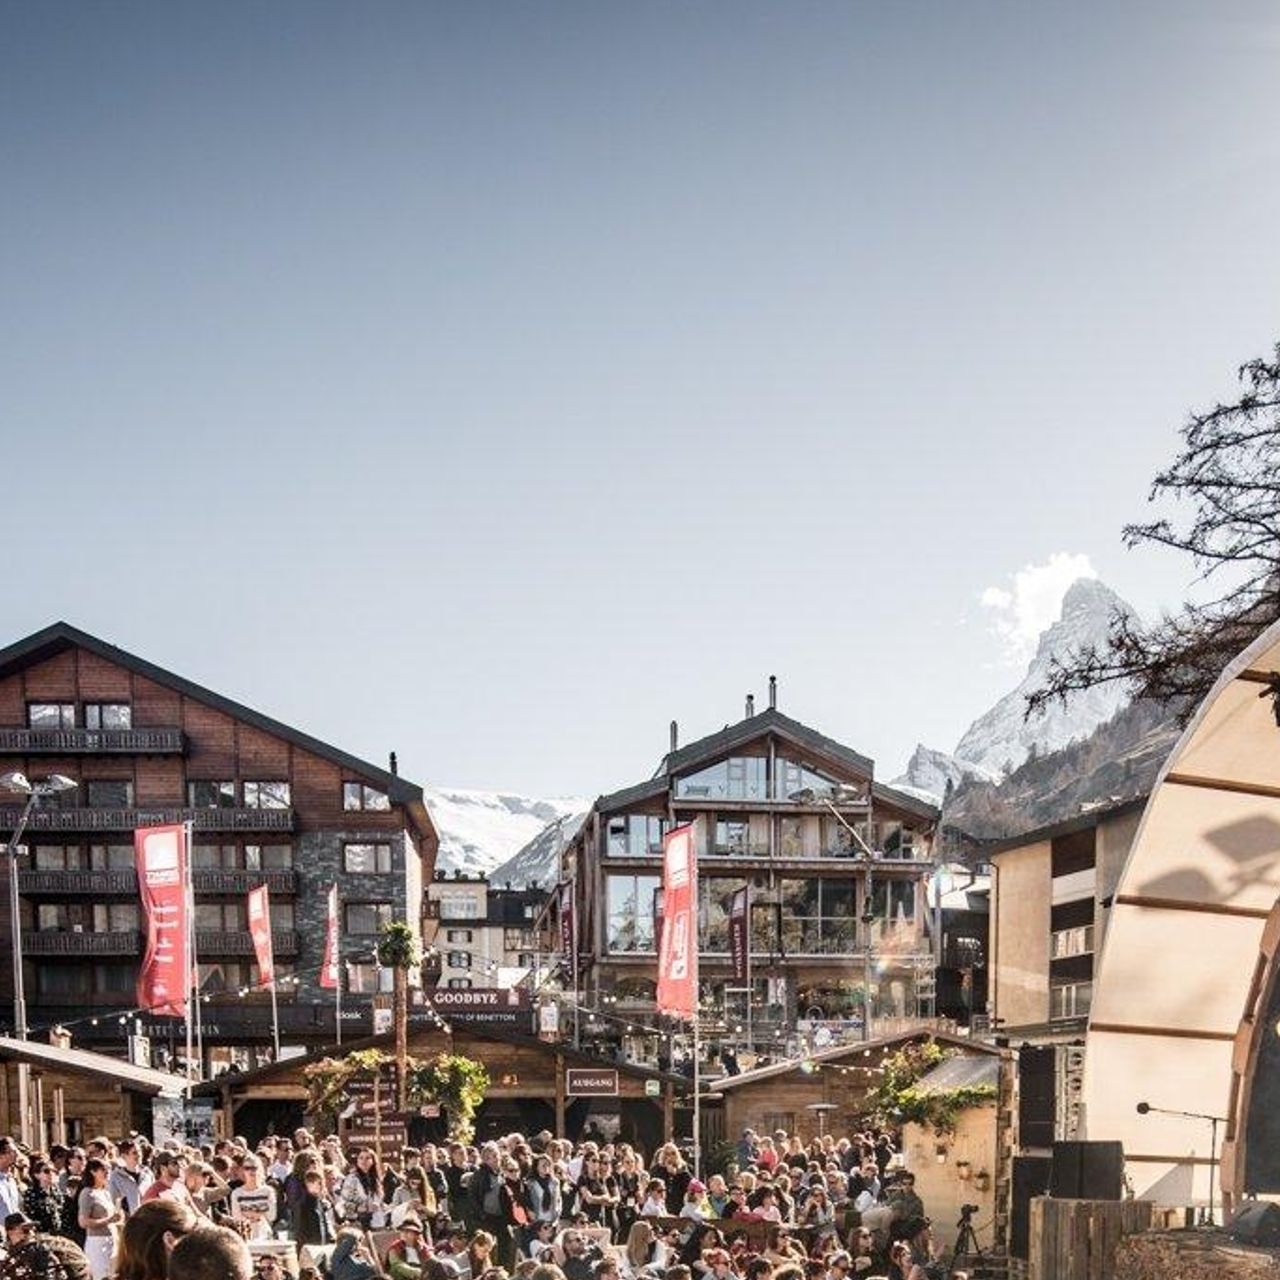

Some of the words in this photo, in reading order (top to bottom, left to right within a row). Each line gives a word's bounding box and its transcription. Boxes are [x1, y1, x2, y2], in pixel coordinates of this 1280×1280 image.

[433, 992, 499, 1005] GOODBYE
[476, 1013, 516, 1022] BENETTON
[571, 1079, 614, 1087] AUSGANG
